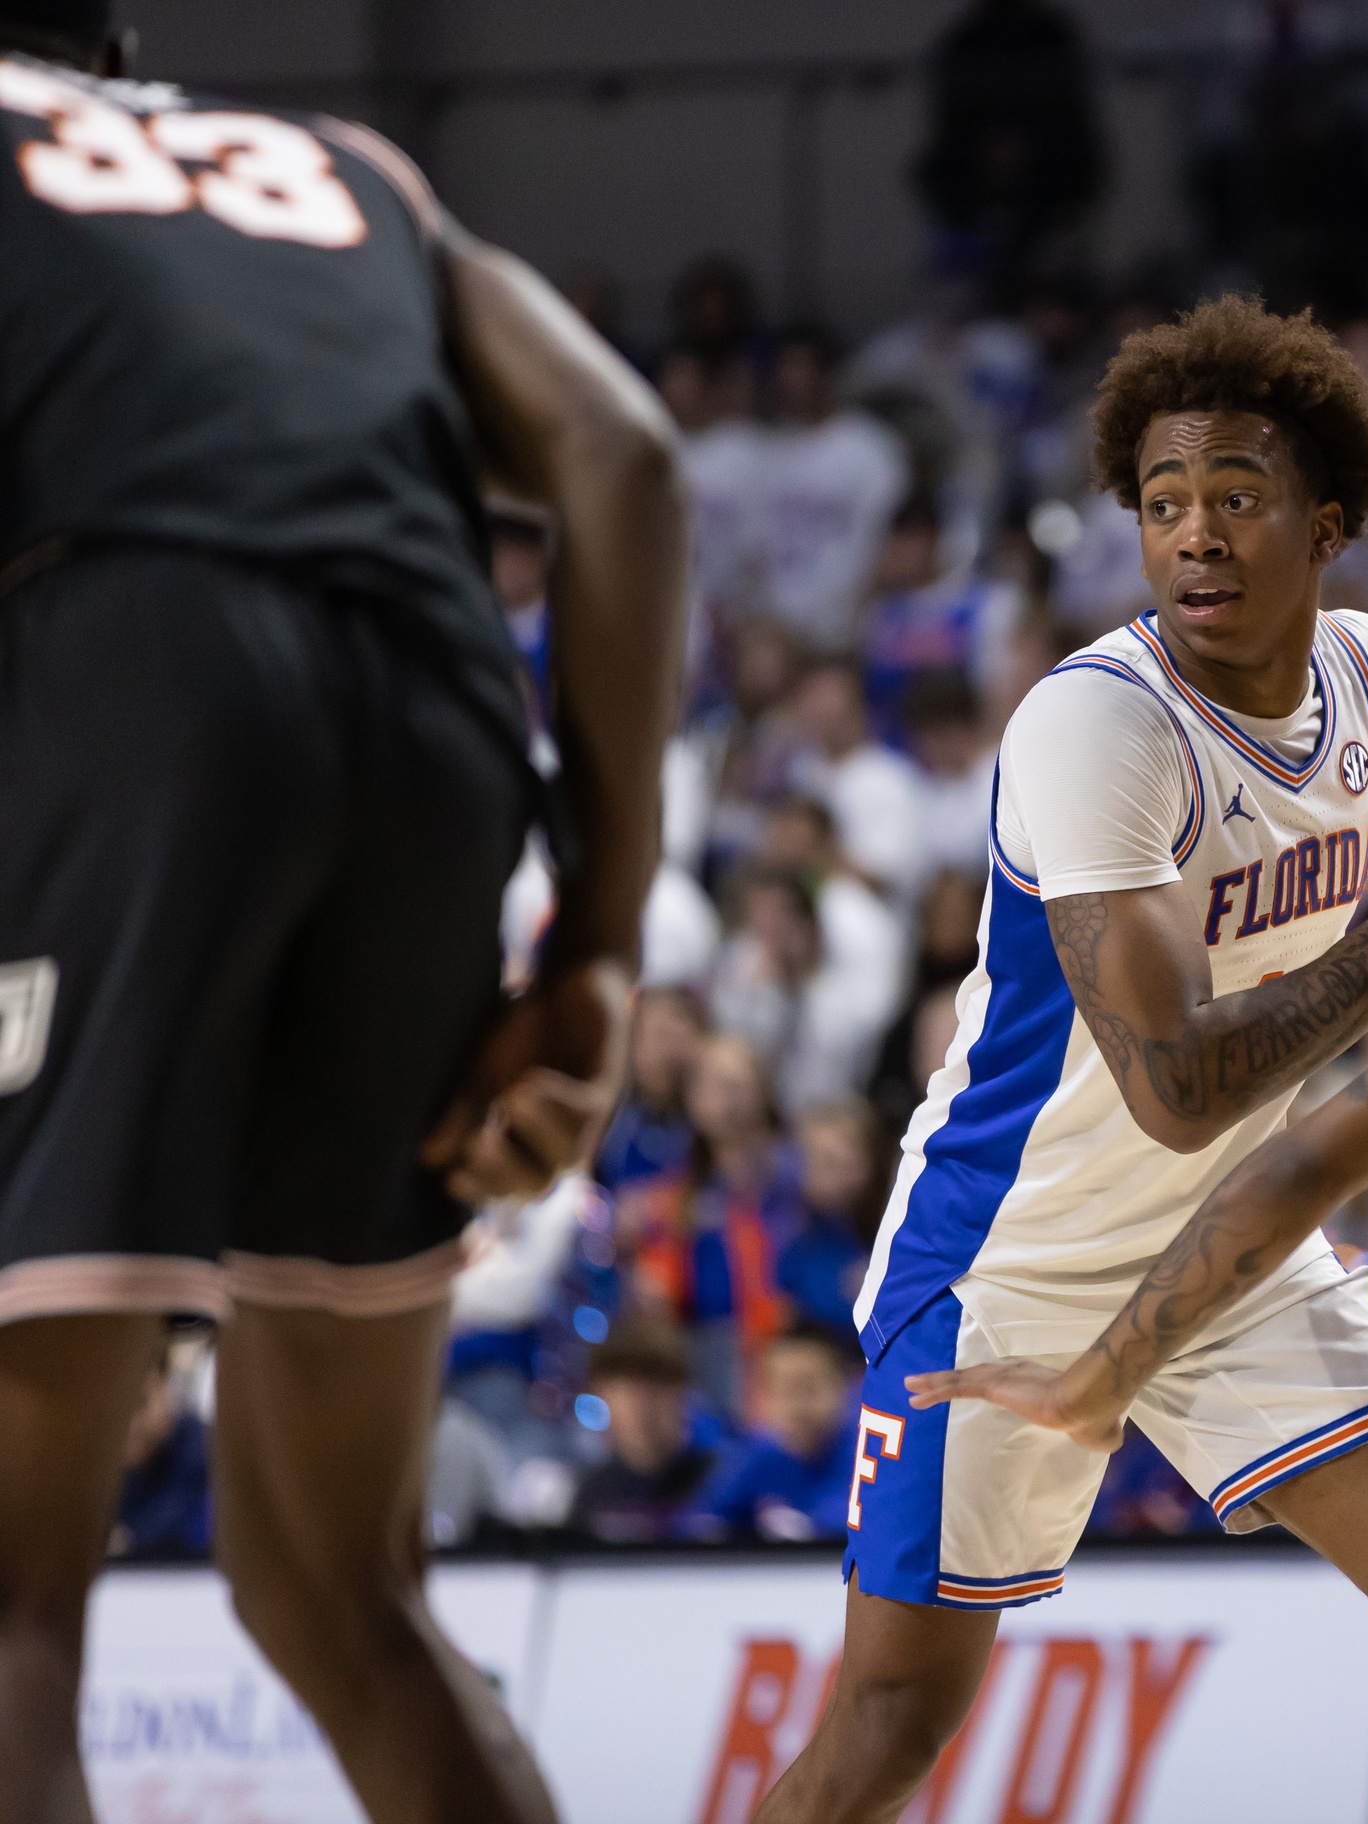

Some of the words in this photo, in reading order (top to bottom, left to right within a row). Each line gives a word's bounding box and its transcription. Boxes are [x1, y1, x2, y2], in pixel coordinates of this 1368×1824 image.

[0, 60, 370, 249] 33
[847, 1402, 906, 1532] F
[688, 1634, 1218, 1824] RDY
